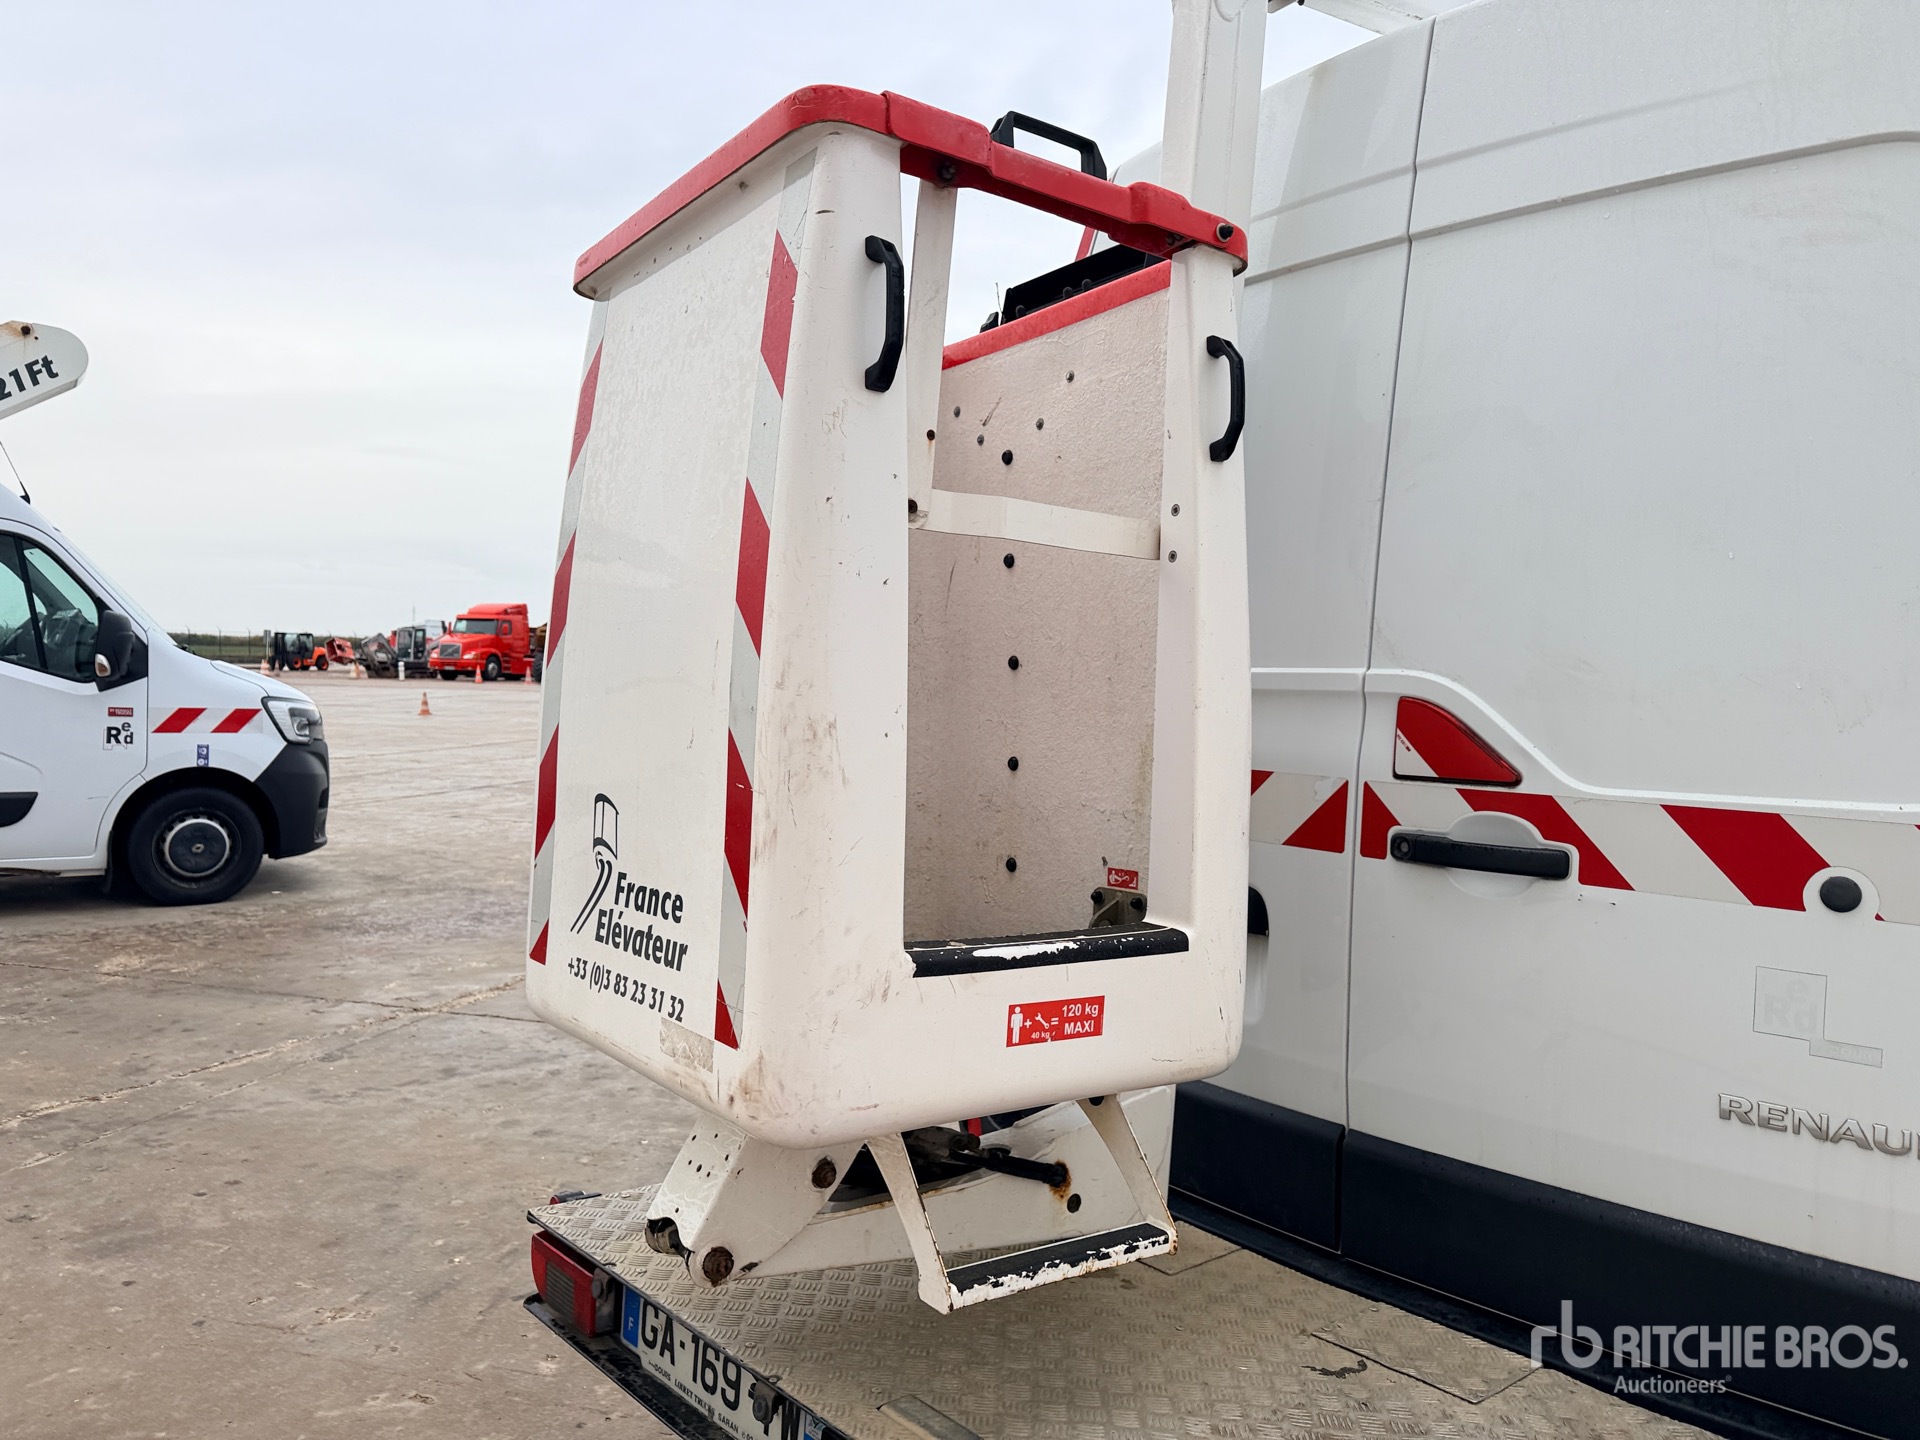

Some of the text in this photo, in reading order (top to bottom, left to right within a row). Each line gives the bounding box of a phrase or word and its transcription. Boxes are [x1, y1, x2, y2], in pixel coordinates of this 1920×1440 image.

[614, 872, 684, 923] France
[595, 909, 688, 971] Elévateur
[568, 957, 685, 1023] +33 (0)3 83 23 31 32
[1062, 1003, 1099, 1017] 120 kg
[1041, 1031, 1050, 1039] kg
[1064, 1020, 1094, 1035] MAXI
[1718, 1092, 1920, 1160] RENAU
[627, 1316, 634, 1331] F
